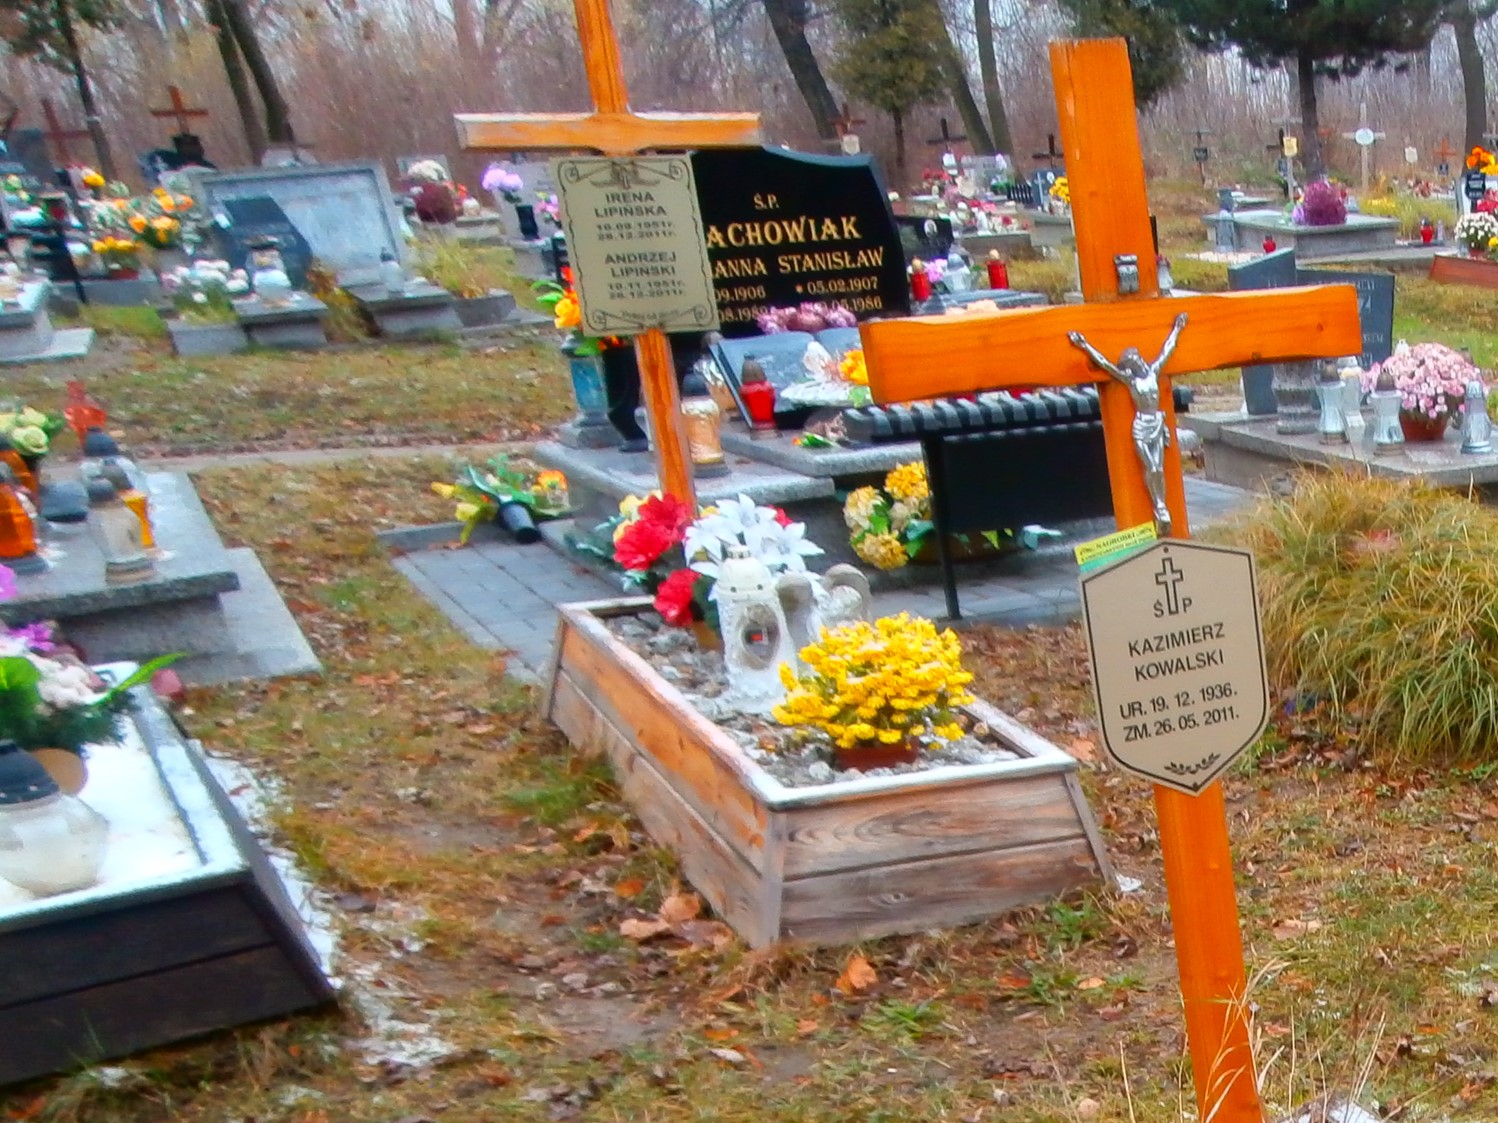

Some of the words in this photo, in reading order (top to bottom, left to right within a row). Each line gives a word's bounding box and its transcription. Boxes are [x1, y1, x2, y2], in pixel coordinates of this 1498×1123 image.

[605, 191, 655, 203] IRENA
[707, 215, 862, 249] ACHOWIAK
[605, 251, 676, 264] ANDRZEJ
[711, 256, 768, 279] ANNA
[778, 246, 884, 274] STANISŁAW
[807, 276, 878, 295] 05.02.1907
[1128, 622, 1225, 658] KAZIMIERZ
[1135, 649, 1224, 682] KOWALSKI
[1119, 701, 1147, 720] UR.
[1150, 696, 1169, 713] 19.
[1174, 691, 1195, 707] 12.
[1199, 682, 1237, 702] 1936.
[1123, 725, 1151, 743] ZM.
[1154, 721, 1175, 737] 26.
[1178, 714, 1199, 730] 05.
[1204, 706, 1239, 726] 2011.
